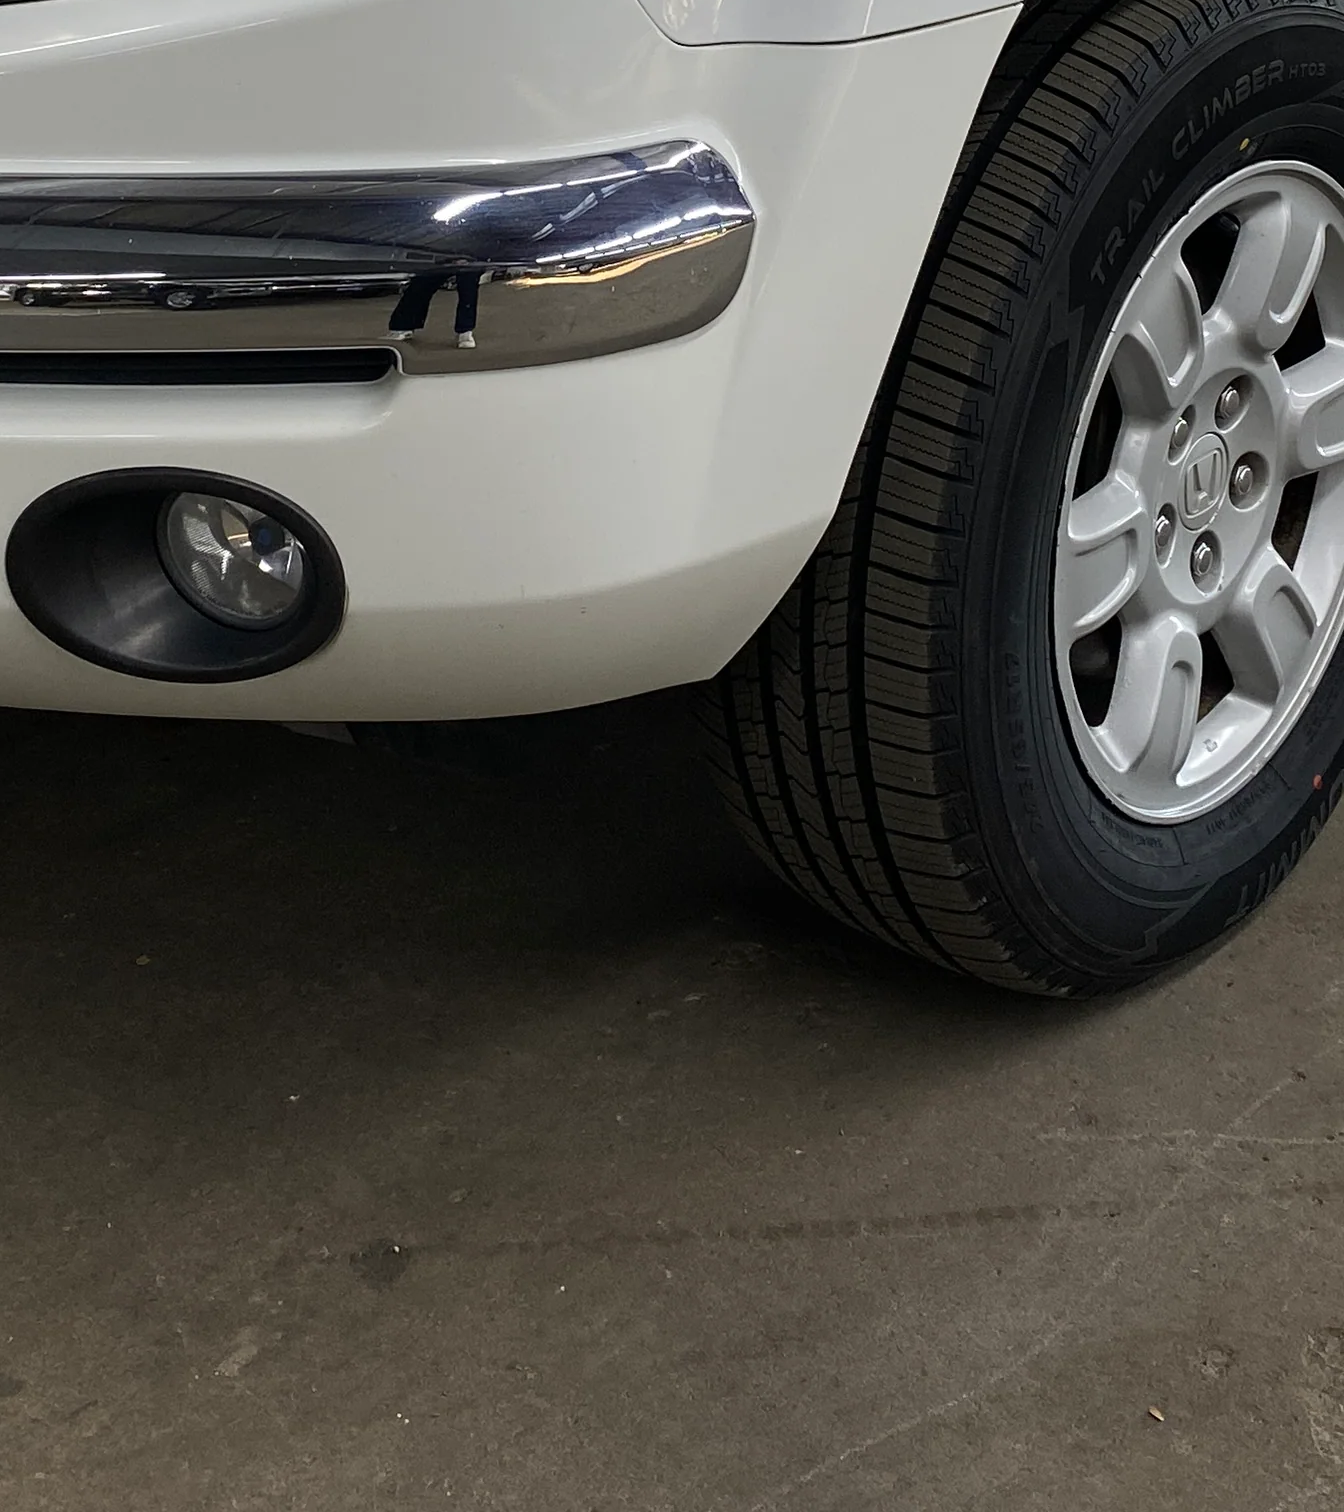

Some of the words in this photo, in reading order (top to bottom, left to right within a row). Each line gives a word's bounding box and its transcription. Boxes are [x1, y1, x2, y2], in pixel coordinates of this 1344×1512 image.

[1089, 168, 1166, 286] TRAIL
[1170, 58, 1286, 162] CLIMBER
[1287, 61, 1328, 80] HT03
